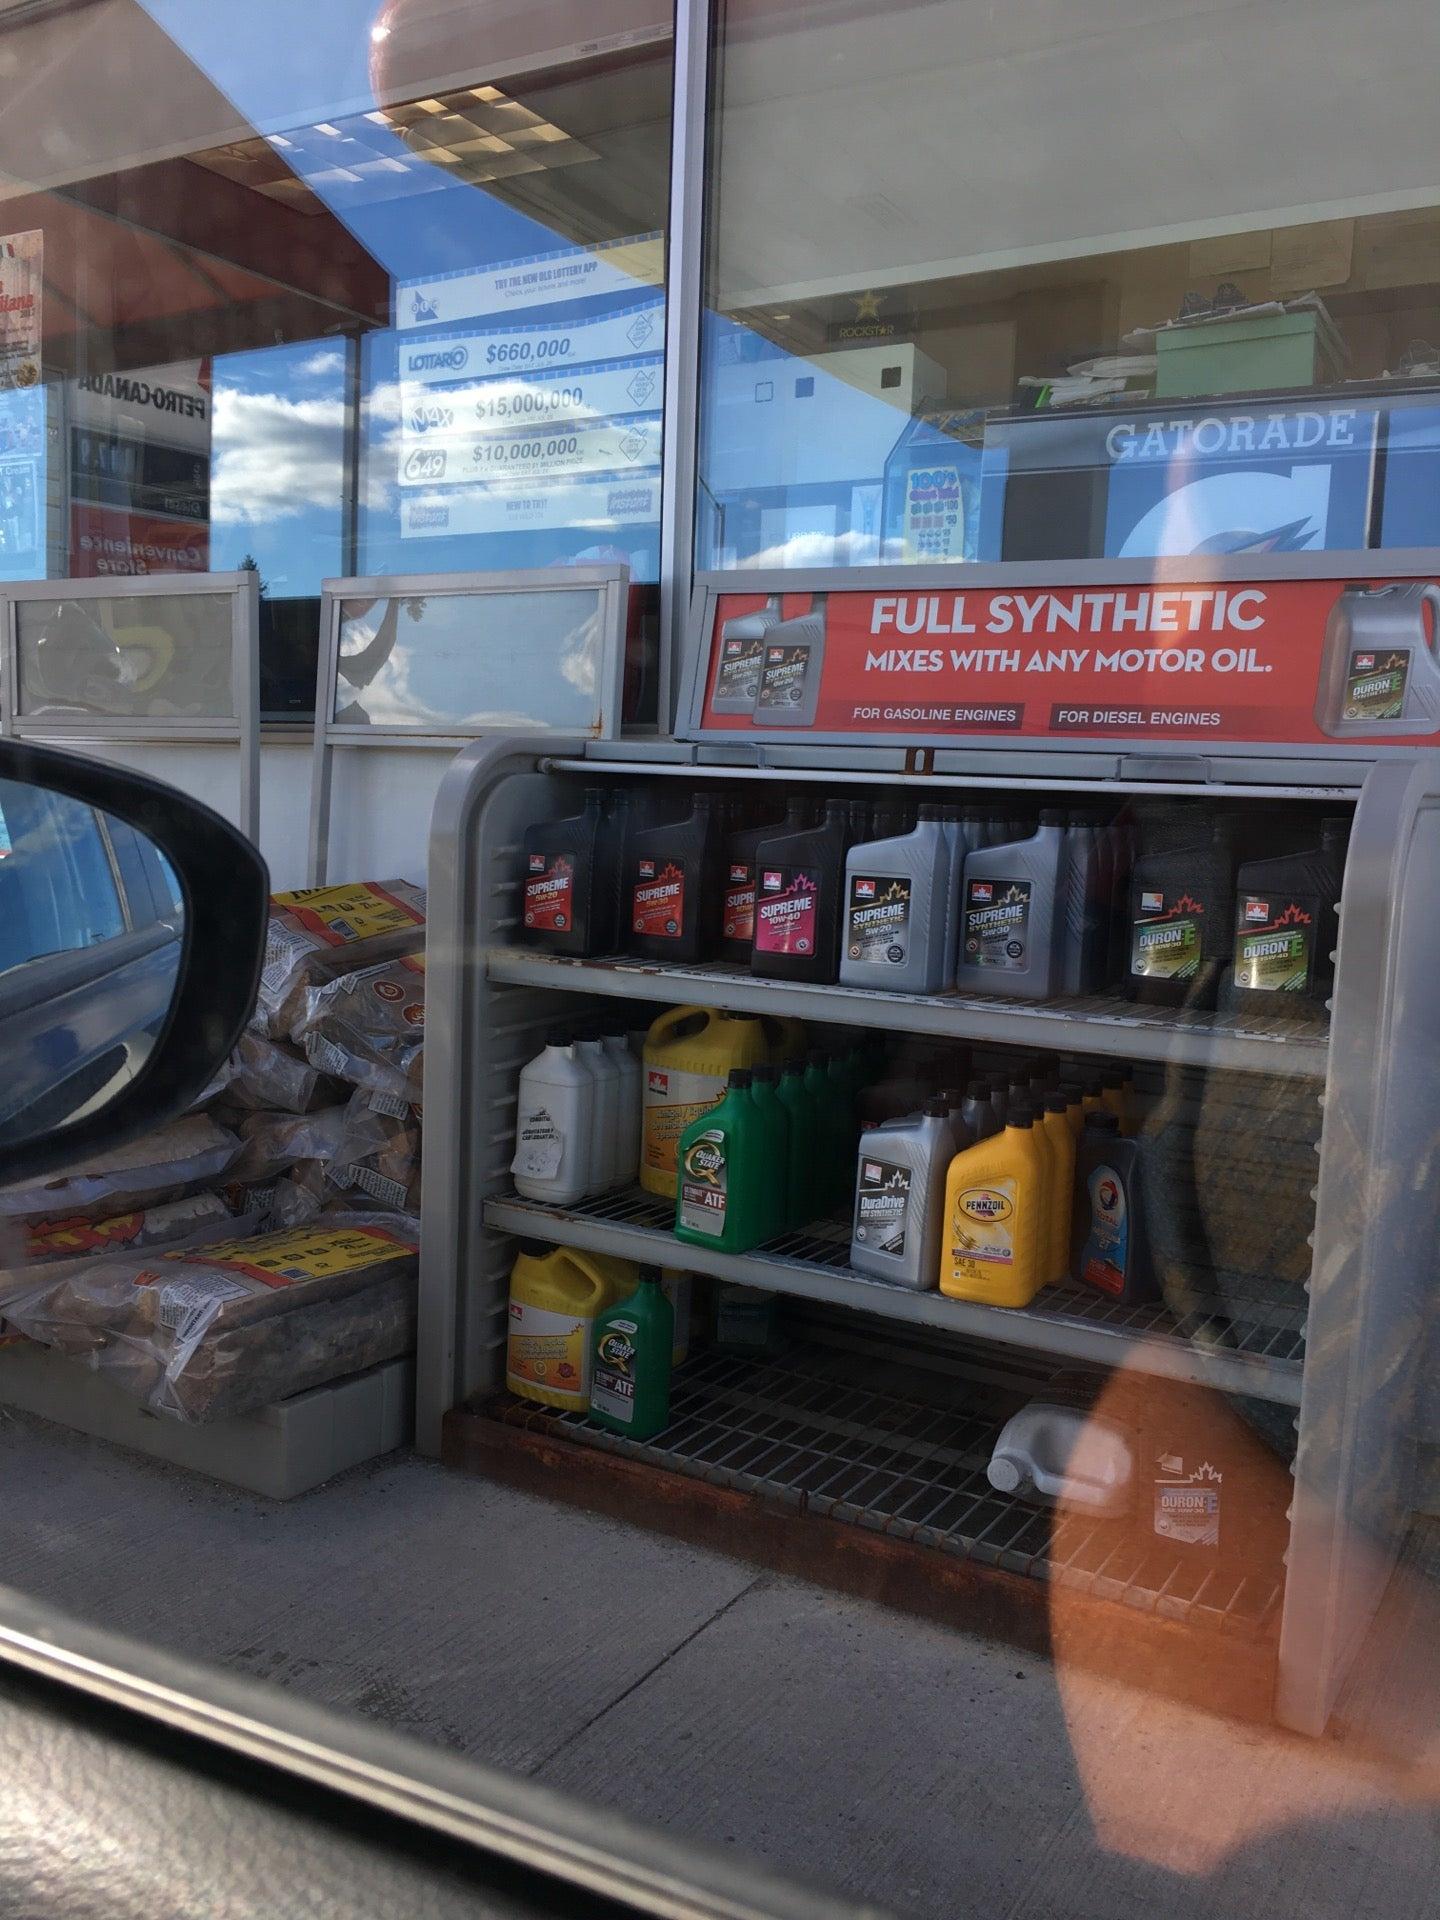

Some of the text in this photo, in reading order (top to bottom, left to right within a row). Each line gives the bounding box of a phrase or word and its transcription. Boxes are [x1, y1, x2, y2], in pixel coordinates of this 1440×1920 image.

[522, 273, 538, 285] NEW
[553, 264, 583, 279] LOTTERY
[584, 261, 598, 273] APP
[408, 346, 469, 372] LOTTARIO
[486, 338, 571, 365] $660,000
[475, 387, 583, 420] $15,000,000
[1106, 408, 1357, 460] GATORADE
[472, 437, 578, 464] $10,000,000
[870, 590, 1268, 634] FULL SYNTHETIC
[723, 655, 763, 671] SUPREME
[864, 648, 1273, 673] MIXES WITH ANY MOTOR OIL.
[766, 662, 806, 679] SUPREME
[853, 708, 1017, 722] FOR GASOLINE ENGINES
[1058, 710, 1221, 726] FOR DIESEL ENGINES
[527, 877, 569, 897] SUPREME
[636, 883, 681, 903] SUPREME
[760, 897, 812, 918] SUPREME
[853, 903, 905, 924] SUPREME
[969, 904, 1024, 926] SUPREME
[769, 912, 800, 924] 10W-40
[853, 914, 905, 931] SYNTHETIC
[969, 916, 1023, 932] SYNTHETIC
[865, 924, 892, 936] 5W-20
[695, 1150, 726, 1165] QUAKER
[698, 1159, 720, 1170] STATE
[704, 1191, 726, 1209] ATF
[860, 1195, 905, 1210] DuraDrive
[966, 1200, 1005, 1210] PENNZOIL
[870, 1208, 903, 1217] SYNTHETIC
[954, 1256, 966, 1267] SAE
[608, 1338, 637, 1355] QUAKER
[611, 1346, 630, 1360] STATE
[614, 1379, 634, 1397] ATF
